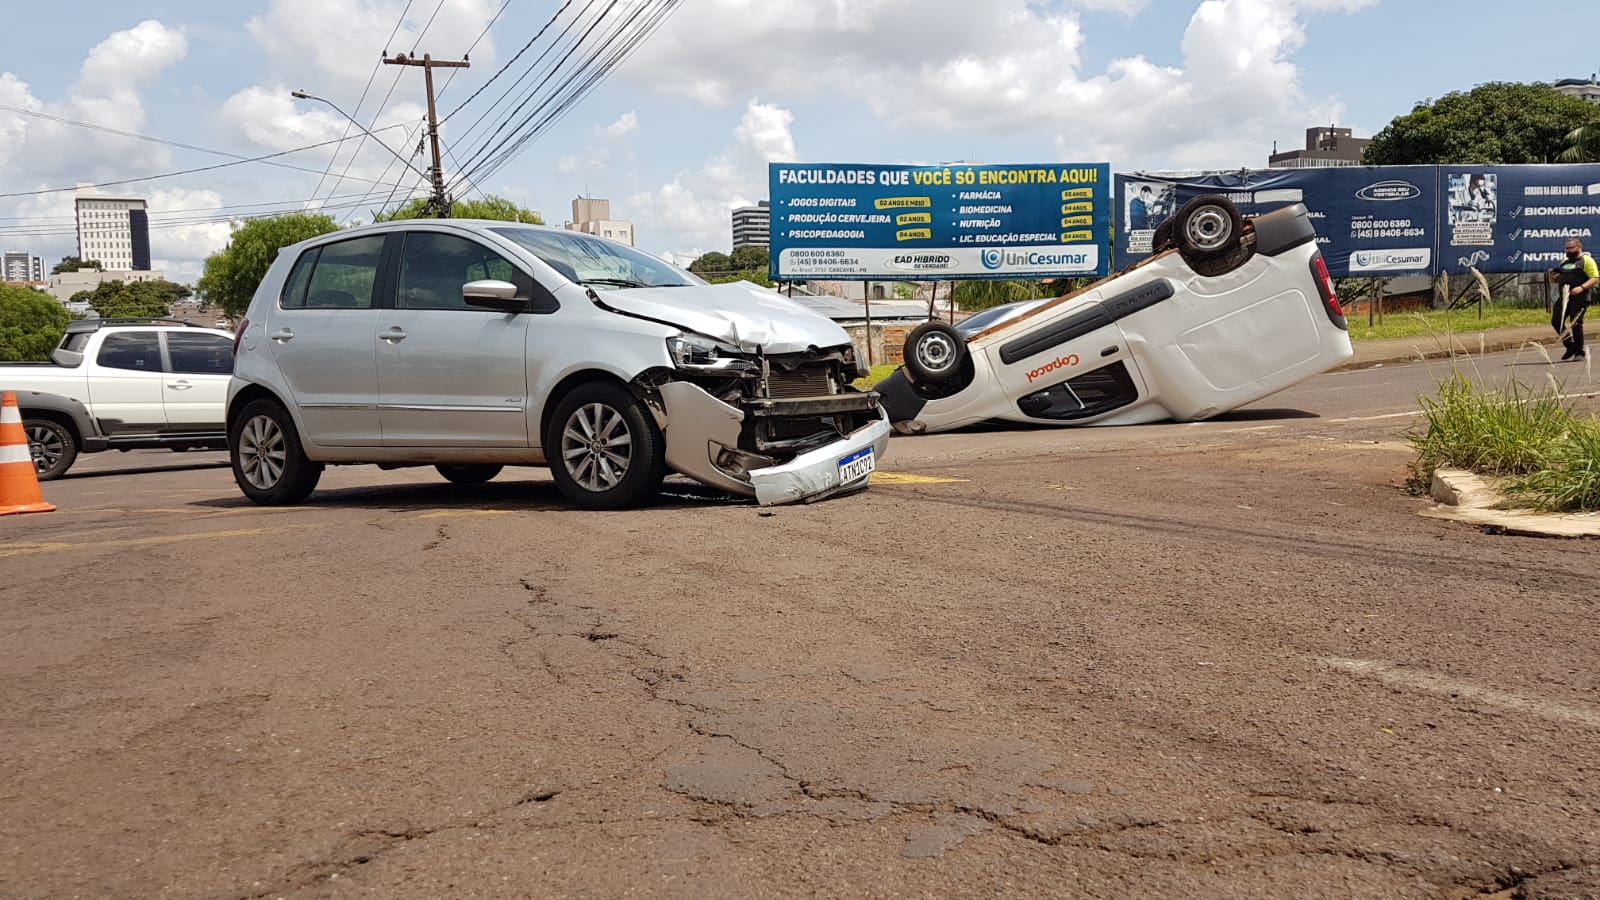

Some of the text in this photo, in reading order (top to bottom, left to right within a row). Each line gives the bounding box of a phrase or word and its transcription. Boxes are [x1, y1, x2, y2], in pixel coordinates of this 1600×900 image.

[779, 168, 1097, 186] FACULDADES QUE VOCÊ SÓ ENCONTRA AQUI!
[959, 189, 1001, 200] FARMÁCIA
[788, 198, 856, 207] JOGOS DIGITAIS
[959, 205, 1012, 214] BIOMEDICINA
[788, 212, 891, 224] PRODUÇÃO CERVEJEIRA
[959, 217, 1001, 229] NUTRIÇÃO
[1352, 220, 1411, 229] 0800 600 6360
[789, 230, 864, 239] PSICOPEDAGOGIA
[1357, 228, 1424, 239] (45) 9 8406-6634
[1523, 227, 1591, 238] FARMÁCIA
[959, 233, 1057, 245] LIC. EDUCAÇÃO ESPECIAL
[895, 255, 912, 263] EAD
[1006, 252, 1087, 266] UniCesumar
[1372, 255, 1423, 264] UniCesumar
[1025, 353, 1079, 383] Copacol
